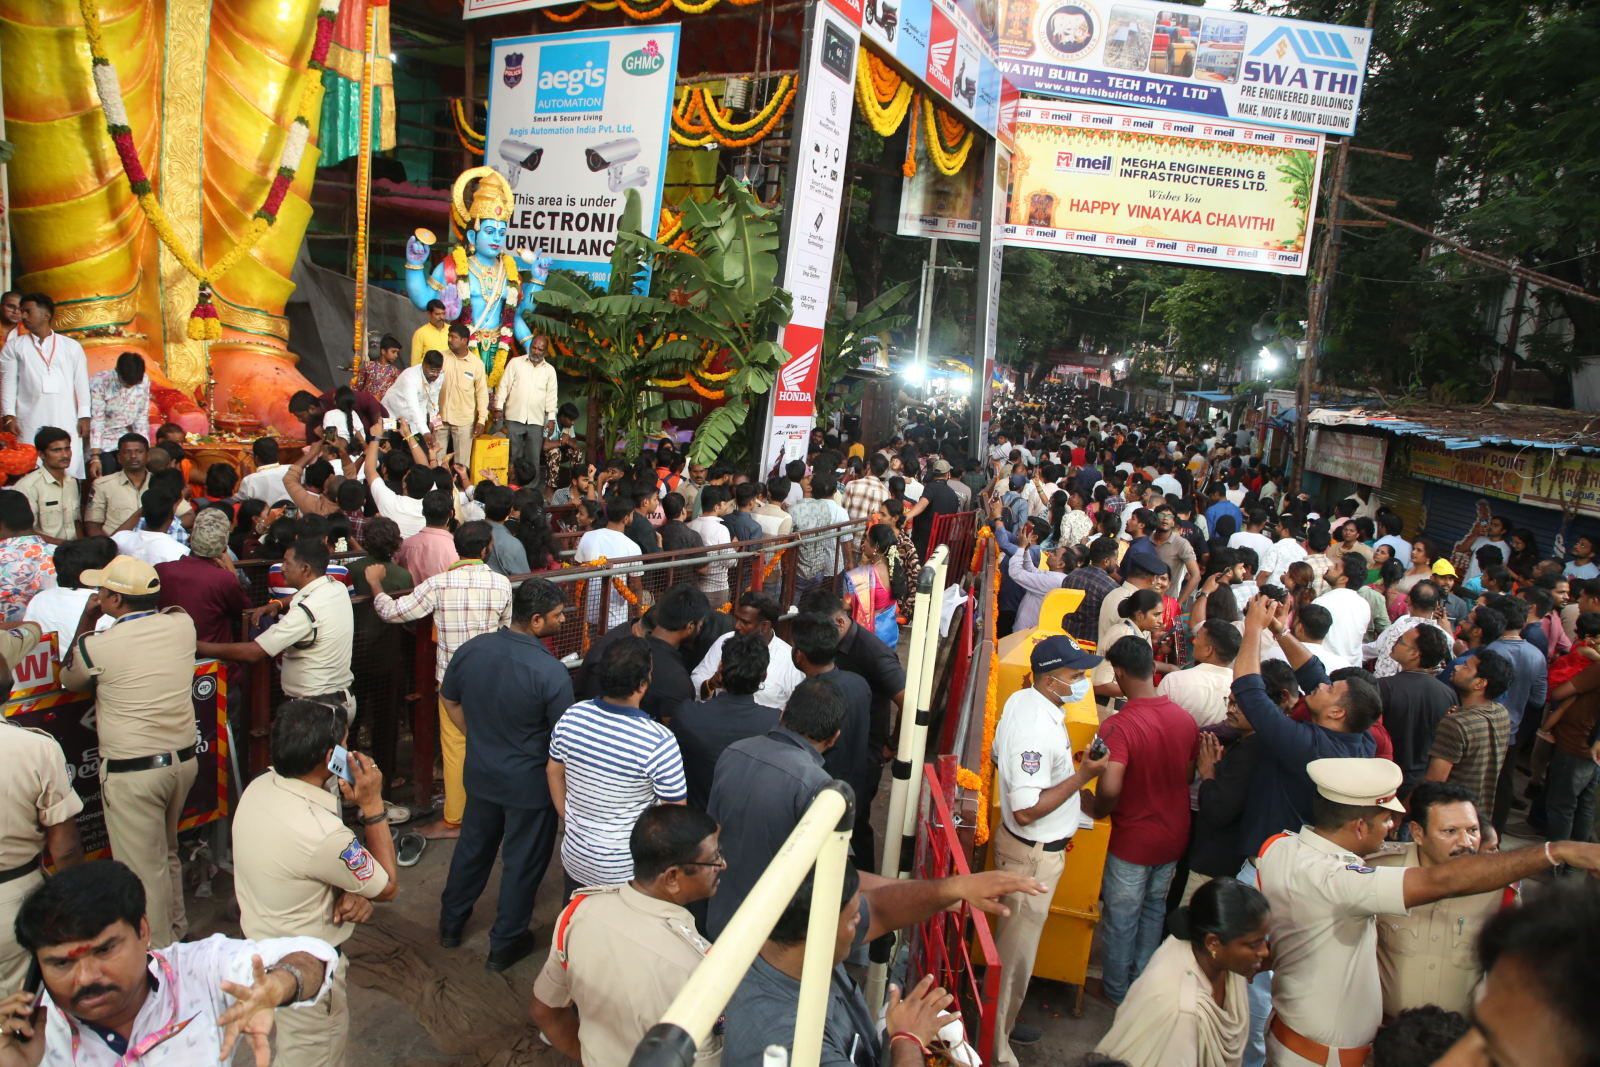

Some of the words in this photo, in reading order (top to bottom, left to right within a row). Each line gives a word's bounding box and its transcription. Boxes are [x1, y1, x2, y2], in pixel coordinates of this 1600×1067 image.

[625, 55, 660, 70] GHMC
[538, 60, 605, 96] aegis
[929, 64, 951, 89] HONDA
[999, 62, 1043, 77] WATHI
[1048, 66, 1089, 84] BUILD
[1108, 76, 1141, 91] TECH
[1146, 82, 1177, 96] PVT.
[1183, 87, 1208, 100] LTD
[1243, 61, 1358, 95] SWATHI
[537, 97, 602, 109] AUTOMATION
[1035, 80, 1167, 105] www.swathibuildtech.in
[1241, 85, 1256, 97] PRE
[1258, 88, 1308, 105] ENGINEERED
[1311, 93, 1353, 111] BUILDINGS
[583, 114, 603, 122] Living
[1238, 102, 1259, 116] MAKE,
[1261, 105, 1281, 120] MOVE
[1283, 109, 1289, 120] &
[1290, 110, 1316, 124] MOUNT
[1318, 113, 1350, 129] BUILDING
[509, 127, 528, 136] Aegis
[530, 126, 574, 136] Automation
[576, 126, 596, 135] India
[598, 125, 615, 134] Pvt.
[617, 124, 635, 134] Ltd.
[1016, 109, 1031, 118] eil
[1051, 113, 1072, 121] meil
[1092, 117, 1113, 125] meil
[1133, 121, 1153, 129] meil
[1174, 125, 1194, 133] meil
[1214, 129, 1234, 138] meil
[1255, 133, 1275, 142] meil
[1295, 137, 1315, 146] meil
[1076, 155, 1112, 171] meil
[1121, 157, 1165, 170] MEGHA
[1169, 162, 1255, 180] ENGINEERING
[1257, 171, 1266, 180] &
[1119, 168, 1239, 190] INFRASTRUCTURES
[1242, 180, 1268, 192] LTD.
[513, 193, 534, 206] This
[538, 196, 562, 206] area
[566, 195, 576, 206] is
[580, 195, 616, 207] under
[1149, 189, 1181, 202] Wishes
[1184, 193, 1201, 204] You
[509, 210, 624, 233] LECTRONI
[957, 220, 977, 230] meil
[1069, 198, 1120, 217] HAPPY
[1127, 204, 1202, 225] VINAYAKA
[1206, 212, 1275, 232] CHAVITHI
[505, 234, 616, 257] URVEILLANC
[1036, 228, 1056, 238] meil
[1076, 232, 1097, 242] meil
[1116, 236, 1136, 246] meil
[1156, 241, 1177, 250] meil
[1197, 246, 1217, 254] meil
[1237, 249, 1258, 258] meil
[1278, 254, 1299, 262] meil
[779, 391, 812, 402] HONDA
